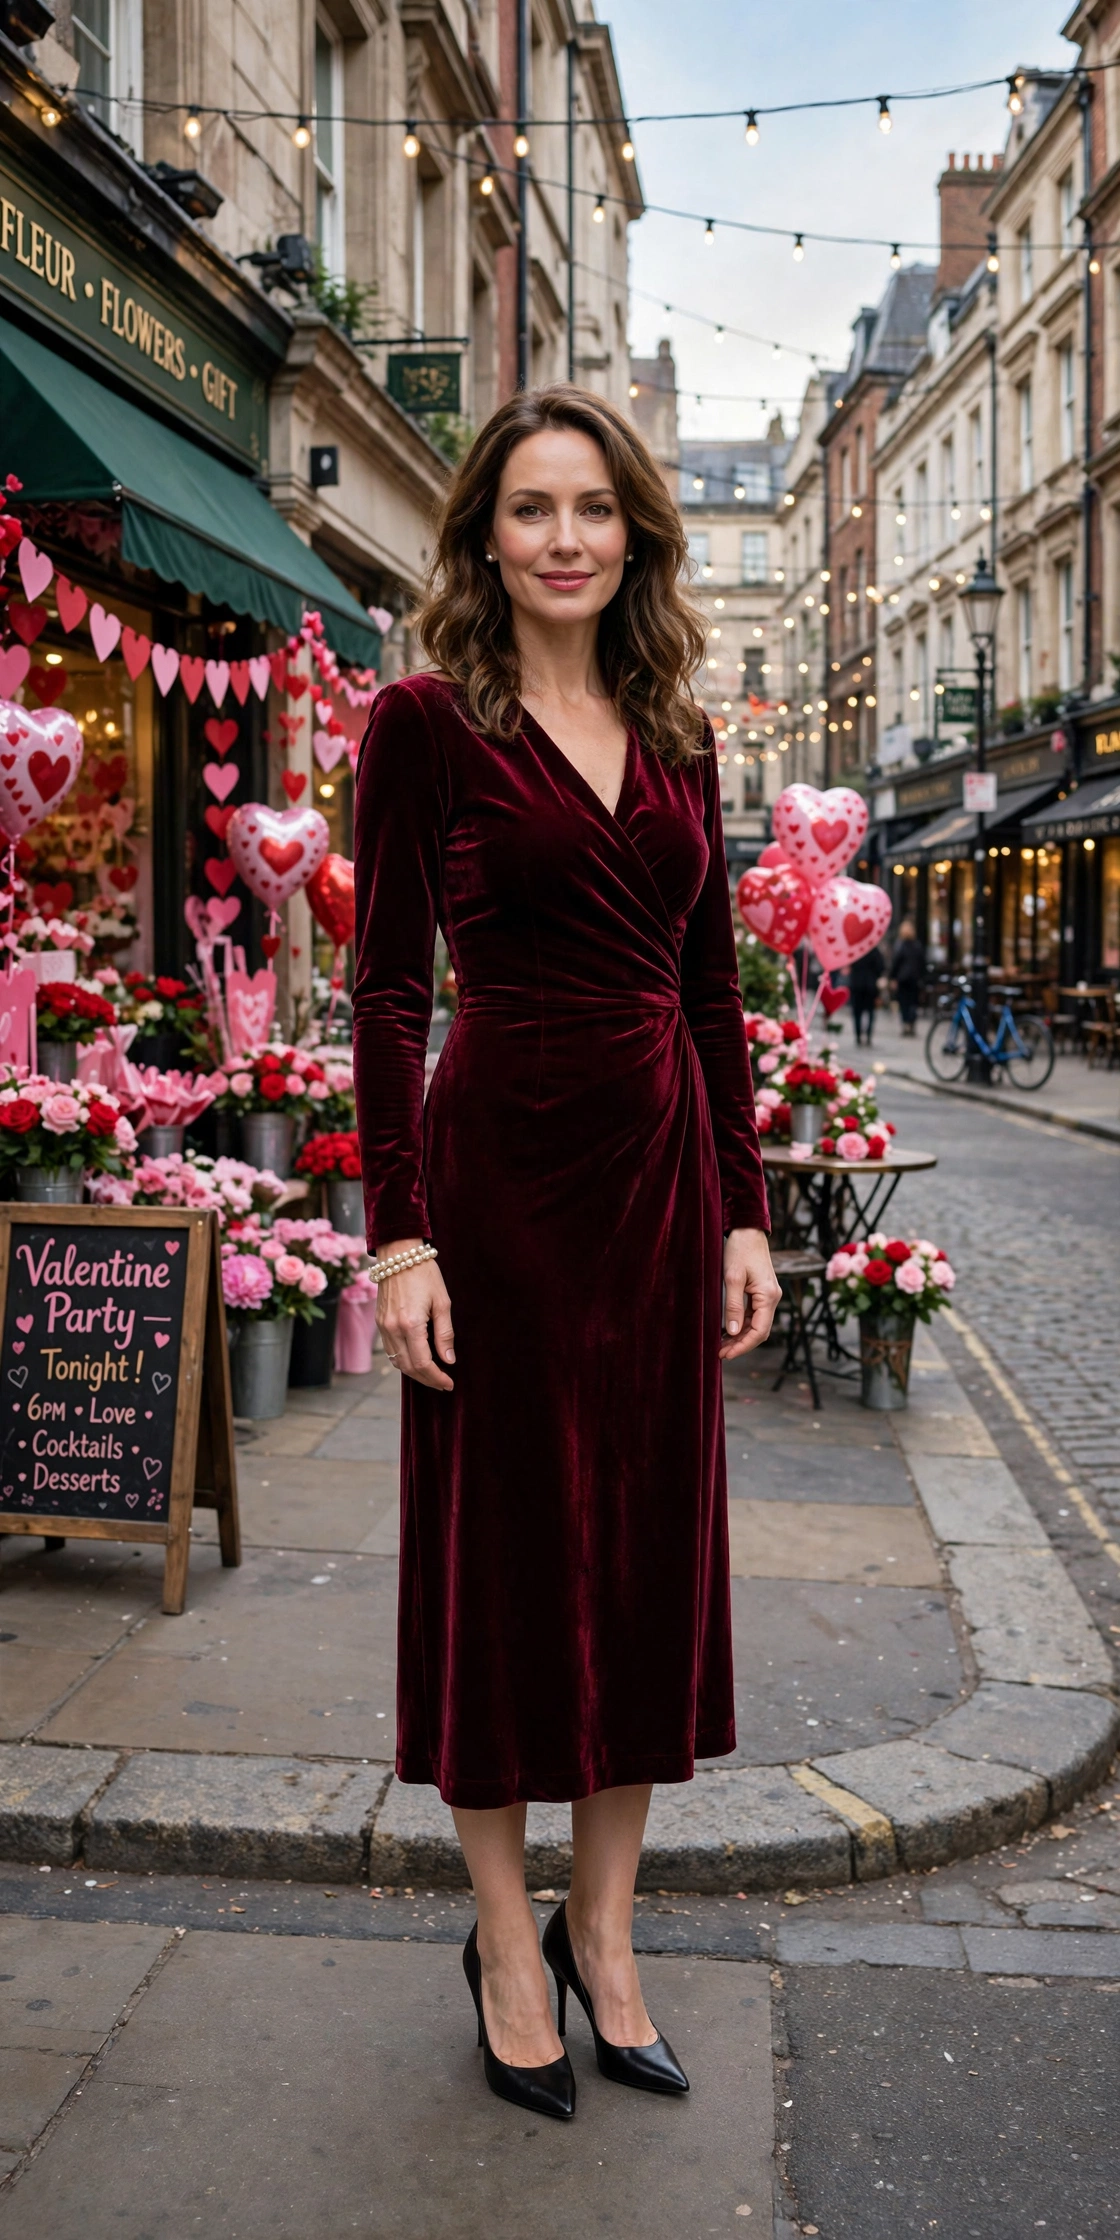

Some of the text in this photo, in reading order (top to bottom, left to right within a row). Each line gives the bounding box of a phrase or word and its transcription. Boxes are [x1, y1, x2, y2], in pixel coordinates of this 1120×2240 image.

[0, 197, 238, 420] FLEUR FLOWERS GIFT
[16, 1238, 171, 1288] Valentine
[44, 1291, 135, 1350] Party
[27, 1392, 136, 1425] 6PM Love
[32, 1429, 123, 1459] Cocktails
[33, 1462, 121, 1492] Desserts
